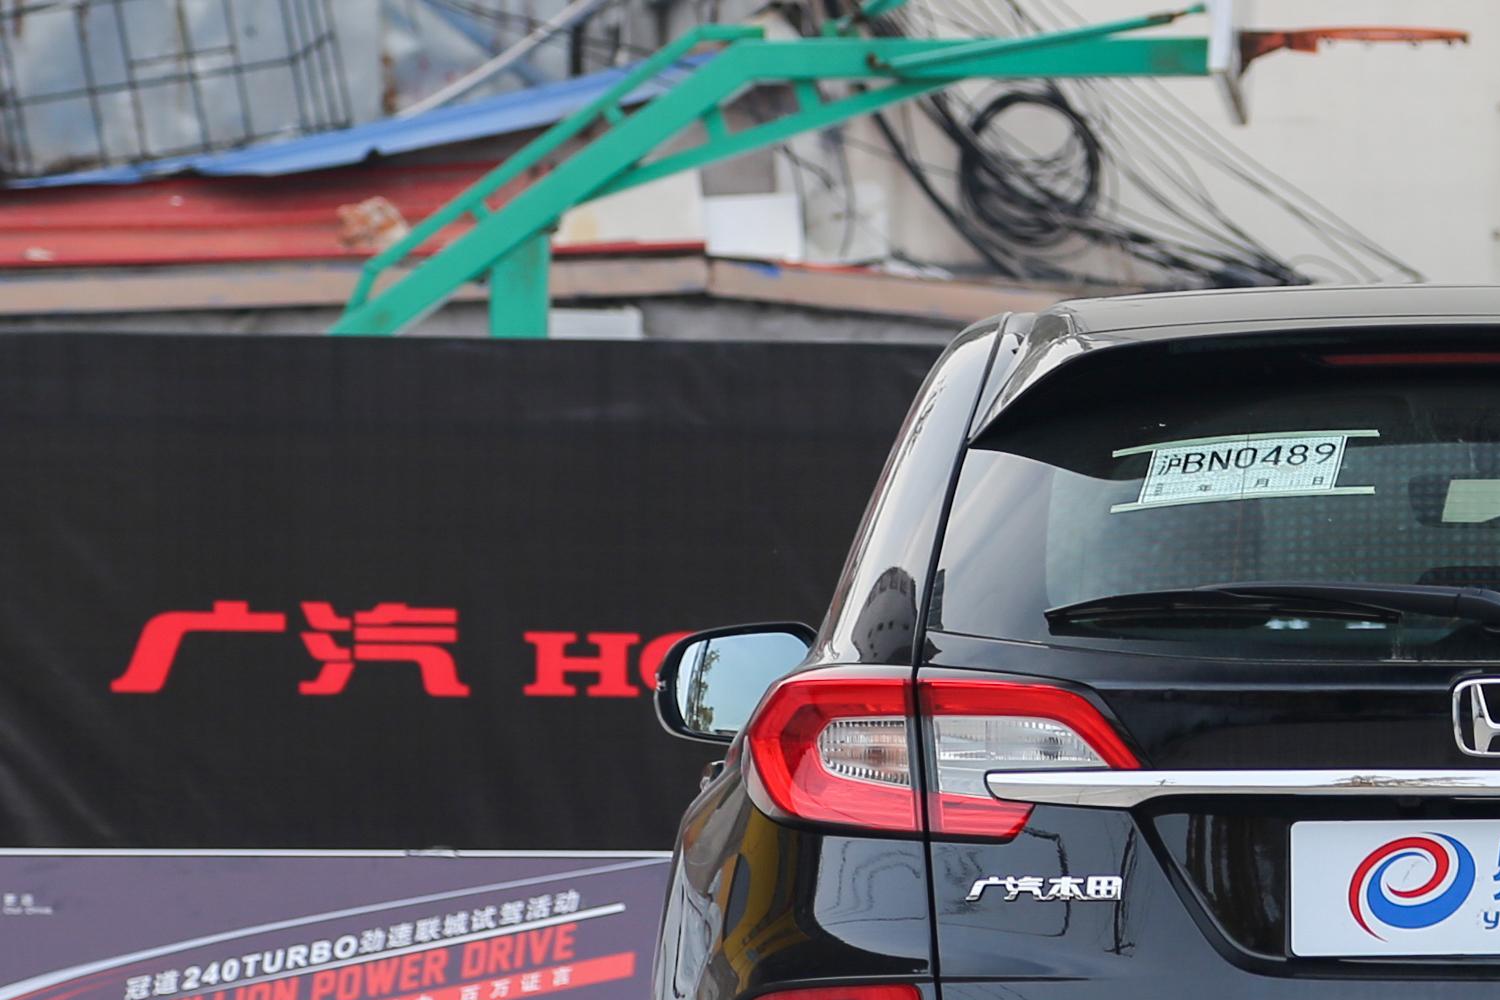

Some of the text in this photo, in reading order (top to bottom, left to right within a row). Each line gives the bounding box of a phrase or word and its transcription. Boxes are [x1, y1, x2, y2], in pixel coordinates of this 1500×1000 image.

[1158, 443, 1337, 476] 沪BN0489
[110, 600, 471, 698] 广汽
[965, 876, 1123, 901] 广汽本田
[460, 922, 580, 980] DRIVE
